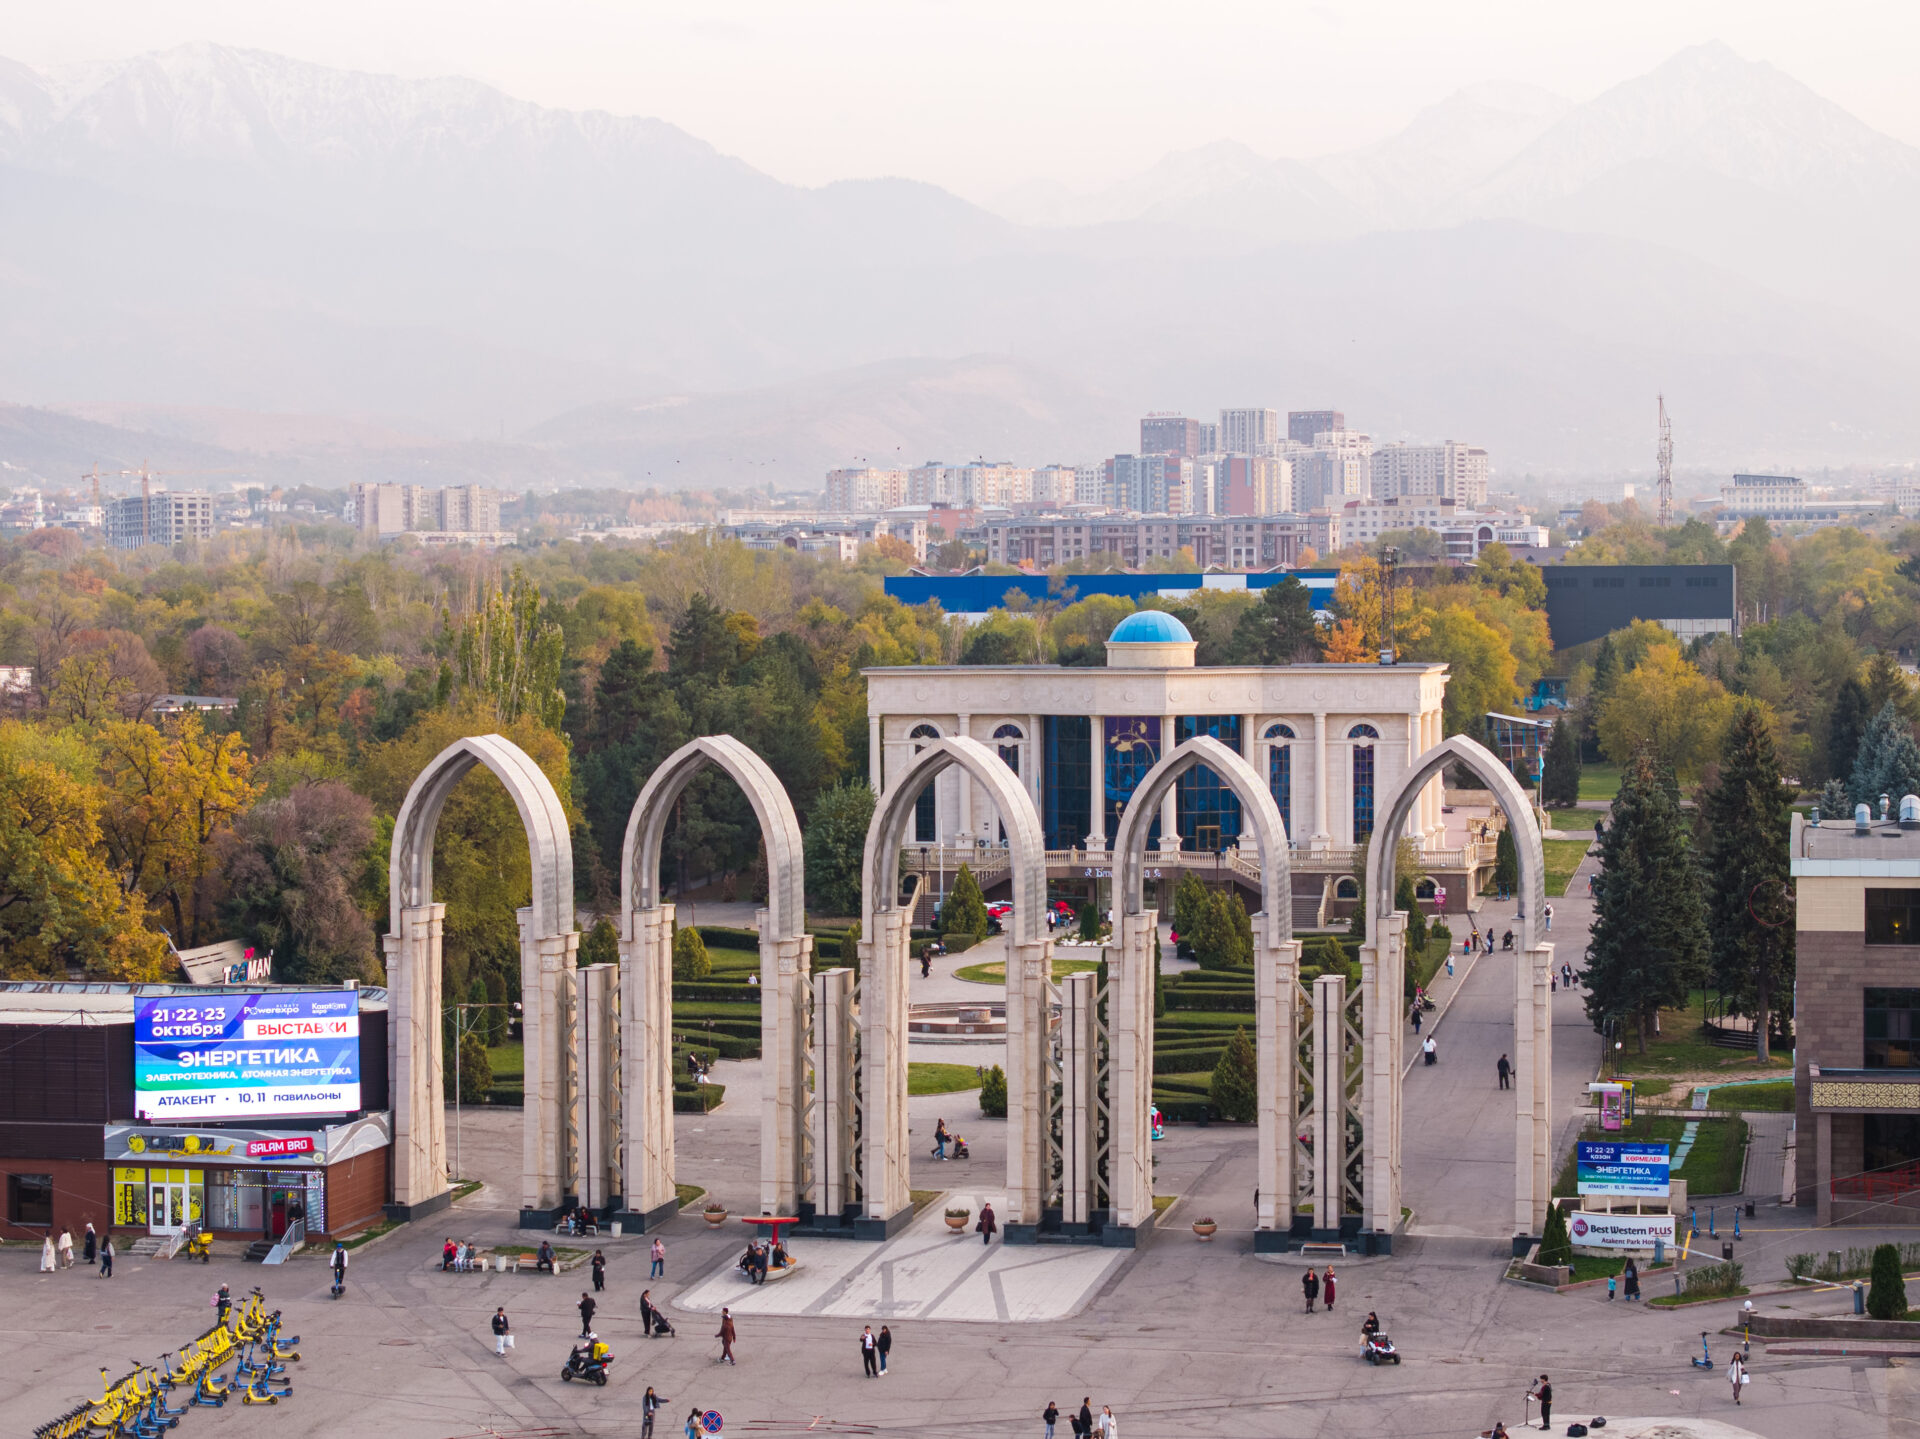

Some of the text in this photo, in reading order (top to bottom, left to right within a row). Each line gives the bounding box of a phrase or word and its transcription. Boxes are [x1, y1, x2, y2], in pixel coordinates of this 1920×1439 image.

[152, 1007, 226, 1022] 21 22 23
[244, 1006, 299, 1015] Powerexpo
[152, 1022, 224, 1037] октября
[257, 1021, 347, 1036] ВЫСТАВКИ
[178, 1047, 320, 1068] ЭНЕРГЕТИКА
[145, 1067, 352, 1082] ЭЛЕКТРОТЕХНИКА, АТОМНАЯ ЭНЕРГЕТИКА
[158, 1092, 341, 1106] АТАКЕНТ 10, 11 павильоны
[250, 1140, 308, 1154] SALAM BRO
[1596, 1166, 1650, 1175] ЭНЕРГЕТИКА
[1590, 1224, 1673, 1235] Best Western PLUS
